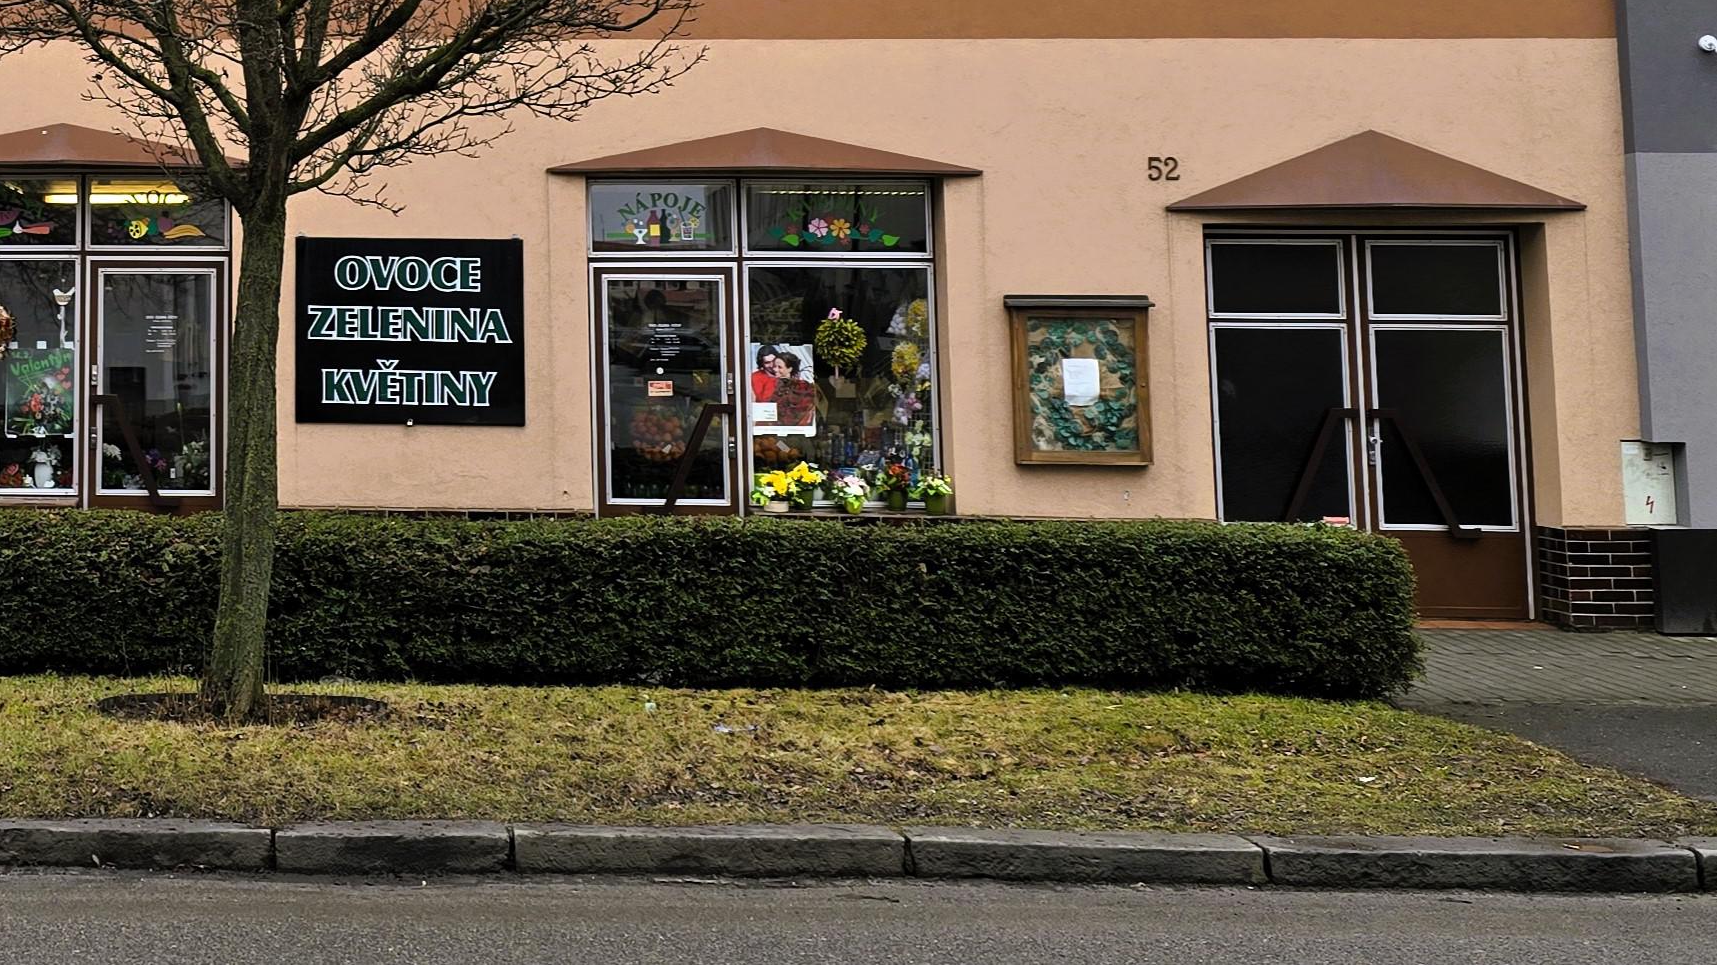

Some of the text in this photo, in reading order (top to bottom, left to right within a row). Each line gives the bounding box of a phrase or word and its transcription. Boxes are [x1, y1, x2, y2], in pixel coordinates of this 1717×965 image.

[1147, 156, 1180, 181] 52
[617, 192, 706, 221] NÁPOJE
[334, 255, 481, 293] OVOCE
[307, 305, 513, 344] ZELENINA
[321, 359, 498, 407] KVĚTINY
